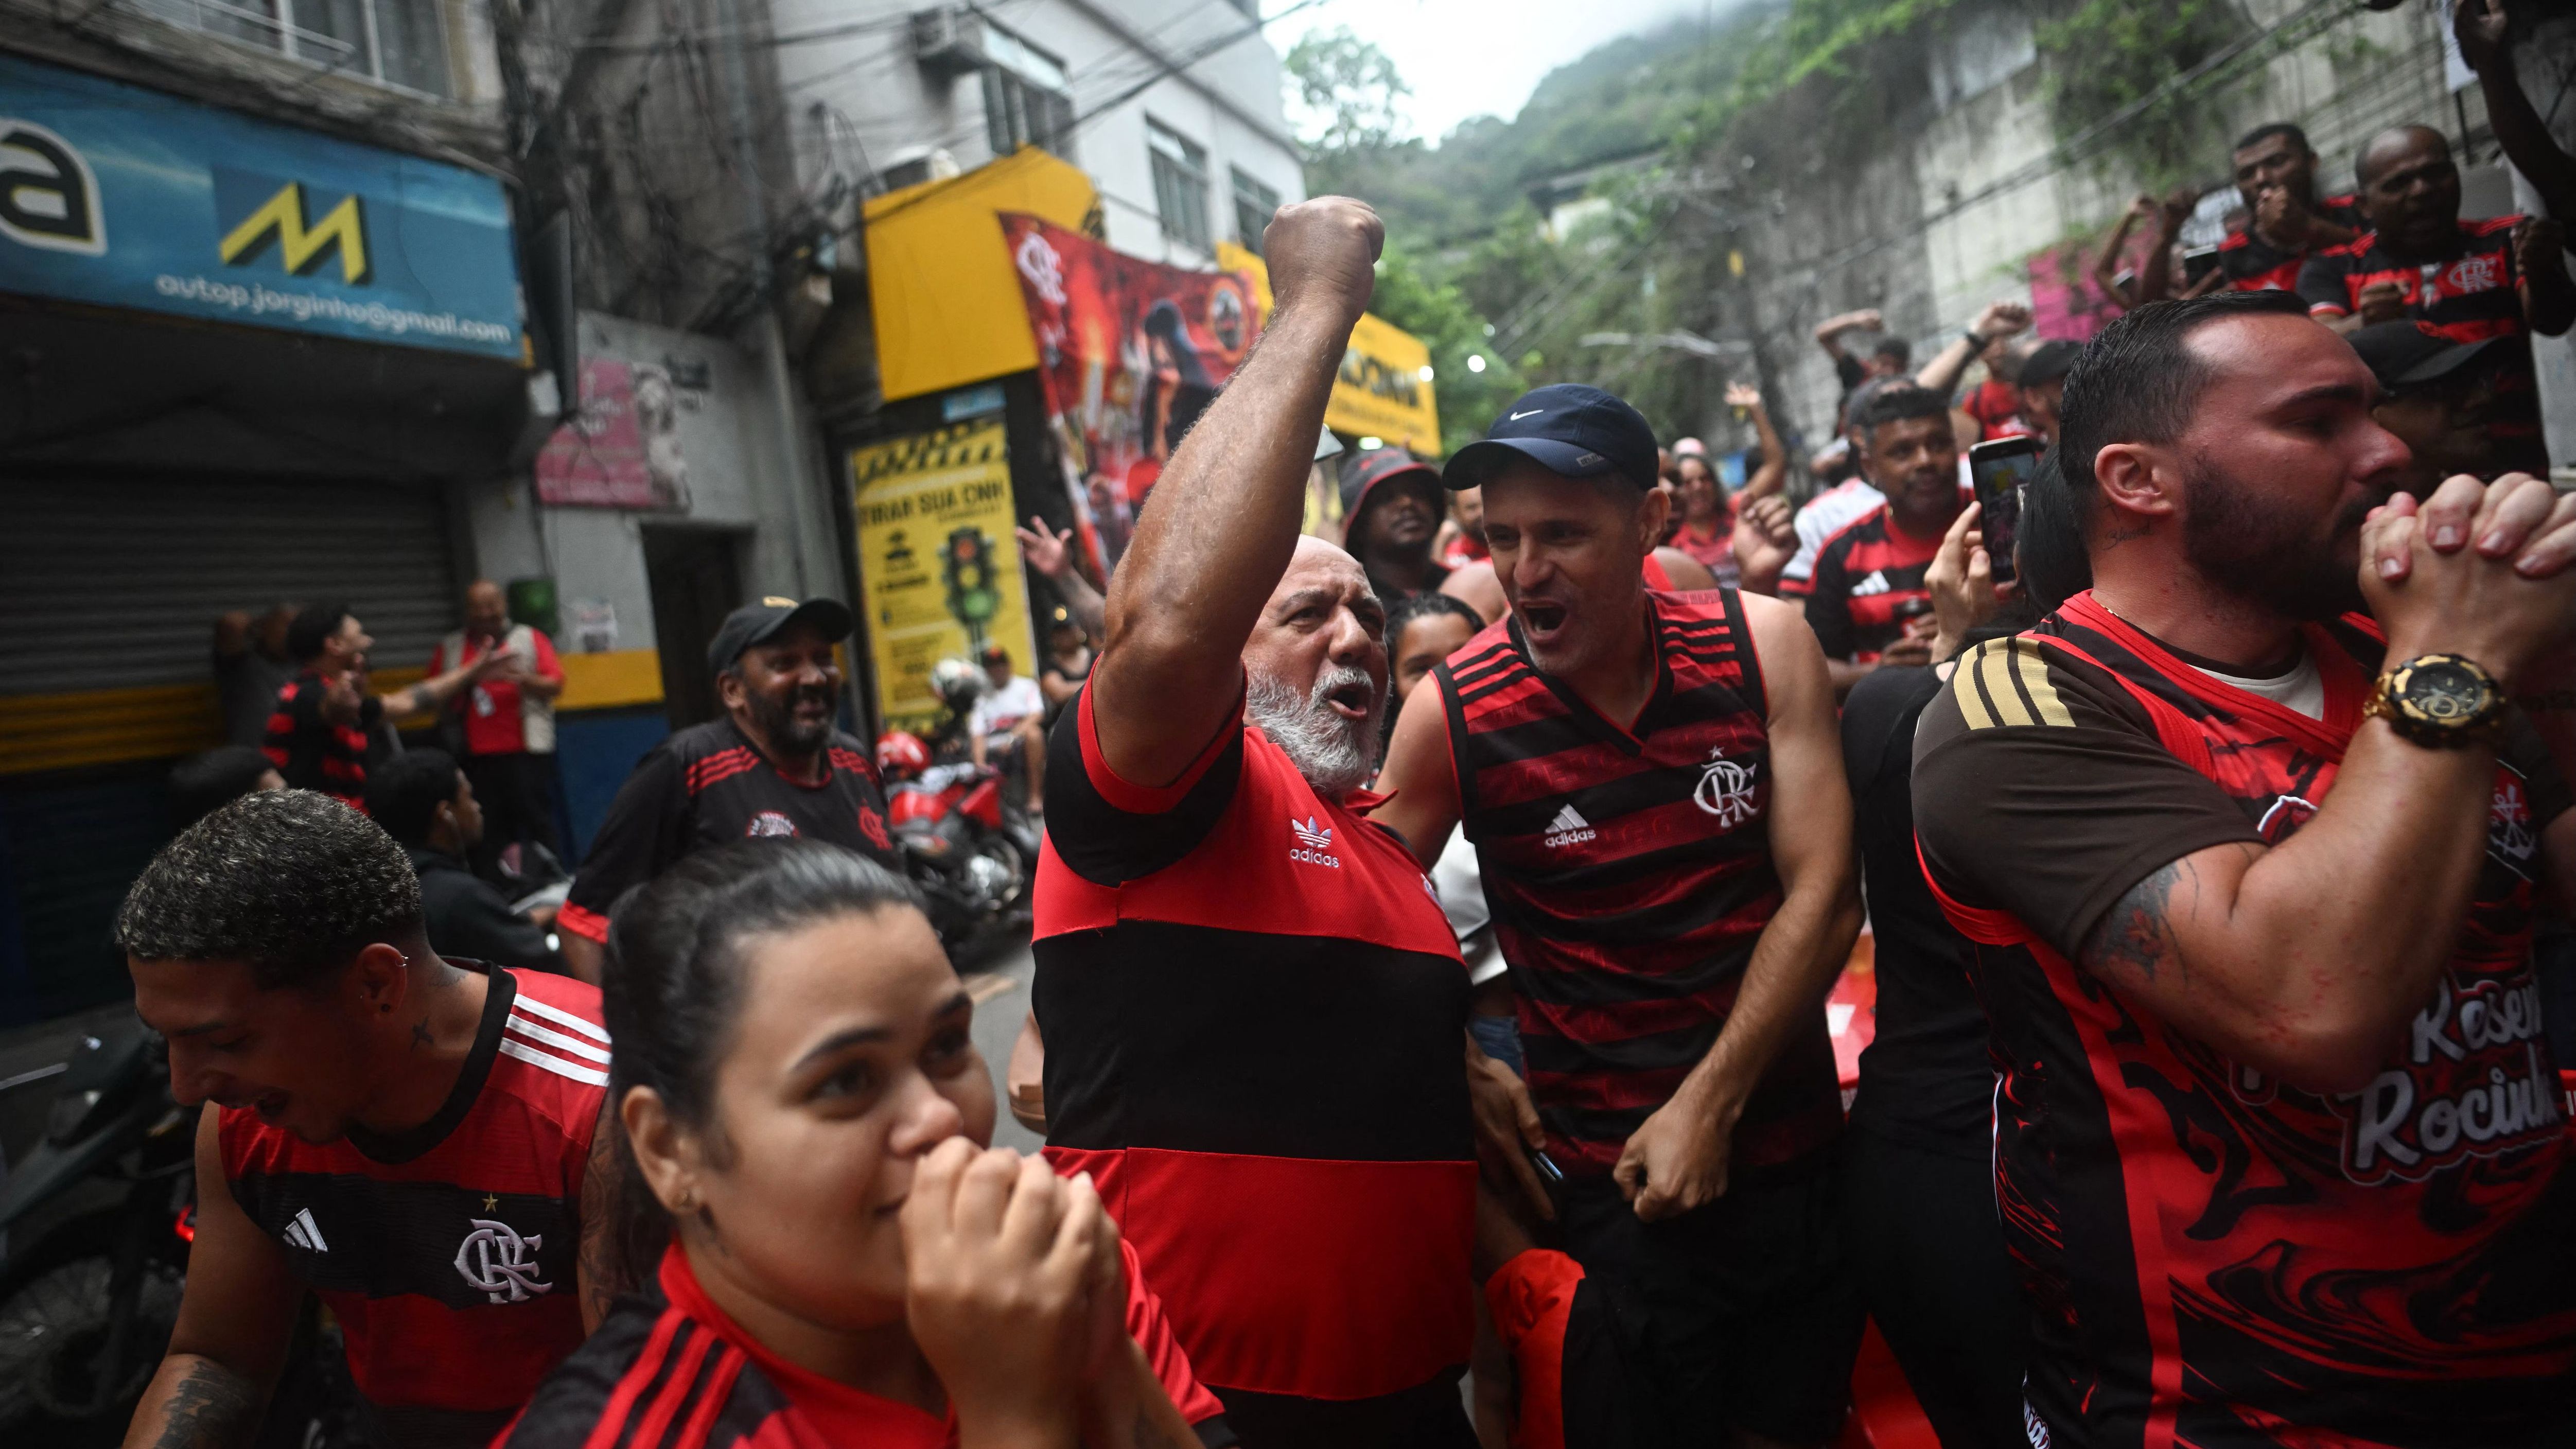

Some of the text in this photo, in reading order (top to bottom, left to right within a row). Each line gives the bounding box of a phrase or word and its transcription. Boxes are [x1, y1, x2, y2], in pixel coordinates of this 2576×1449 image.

[219, 180, 370, 285] M
[156, 273, 511, 343] autop.jorginho@gmail.com
[920, 488, 956, 514] SUA
[1545, 828, 1597, 848] adidas
[1290, 848, 1339, 868] adidas
